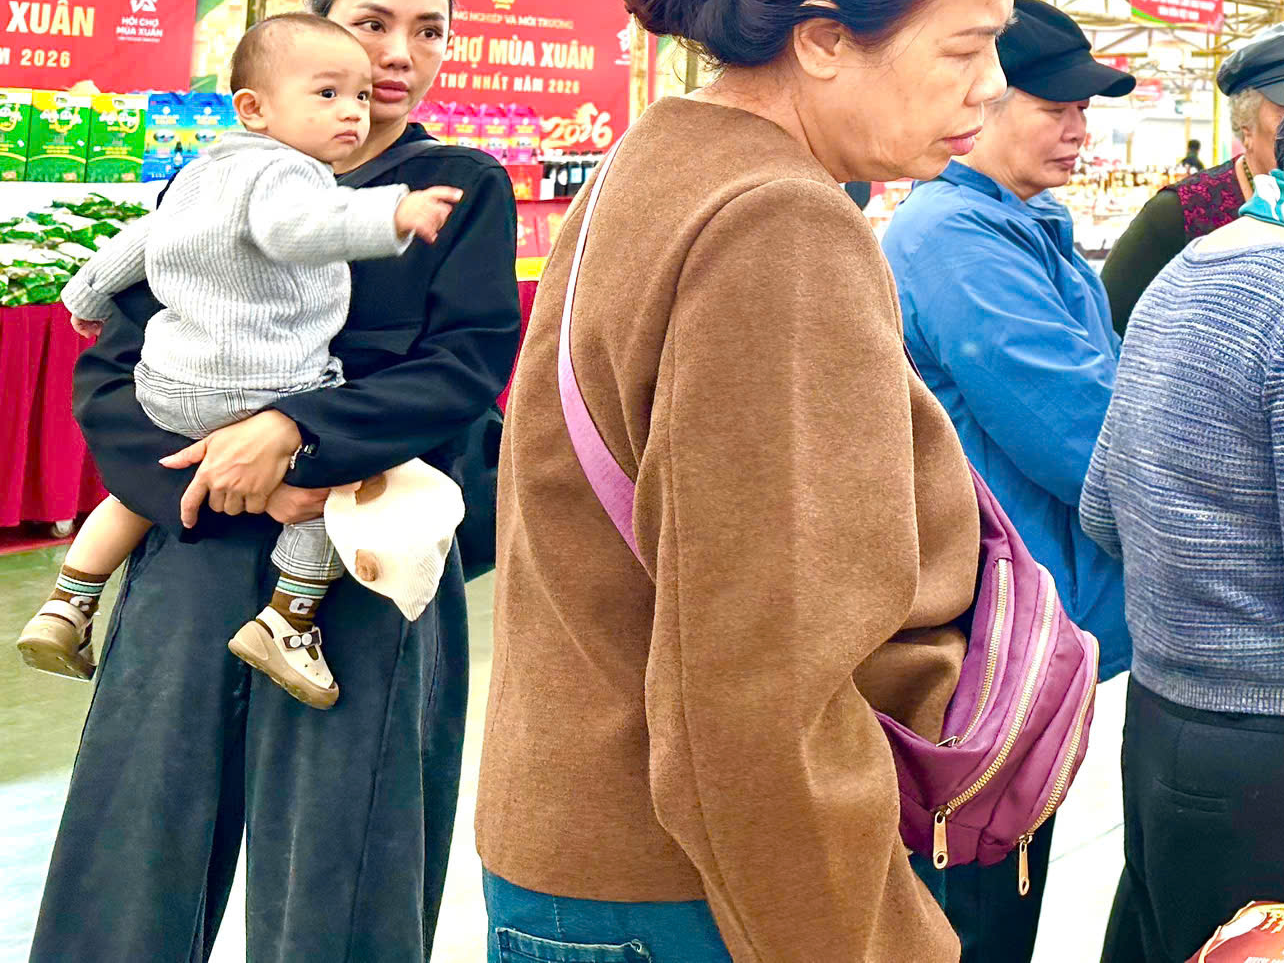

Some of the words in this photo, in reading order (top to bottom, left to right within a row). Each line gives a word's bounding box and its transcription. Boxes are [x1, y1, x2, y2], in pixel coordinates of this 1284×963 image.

[20, 48, 70, 68] 2026
[487, 34, 536, 67] MÙA
[539, 39, 595, 70] XUÂN
[548, 78, 580, 94] 2026
